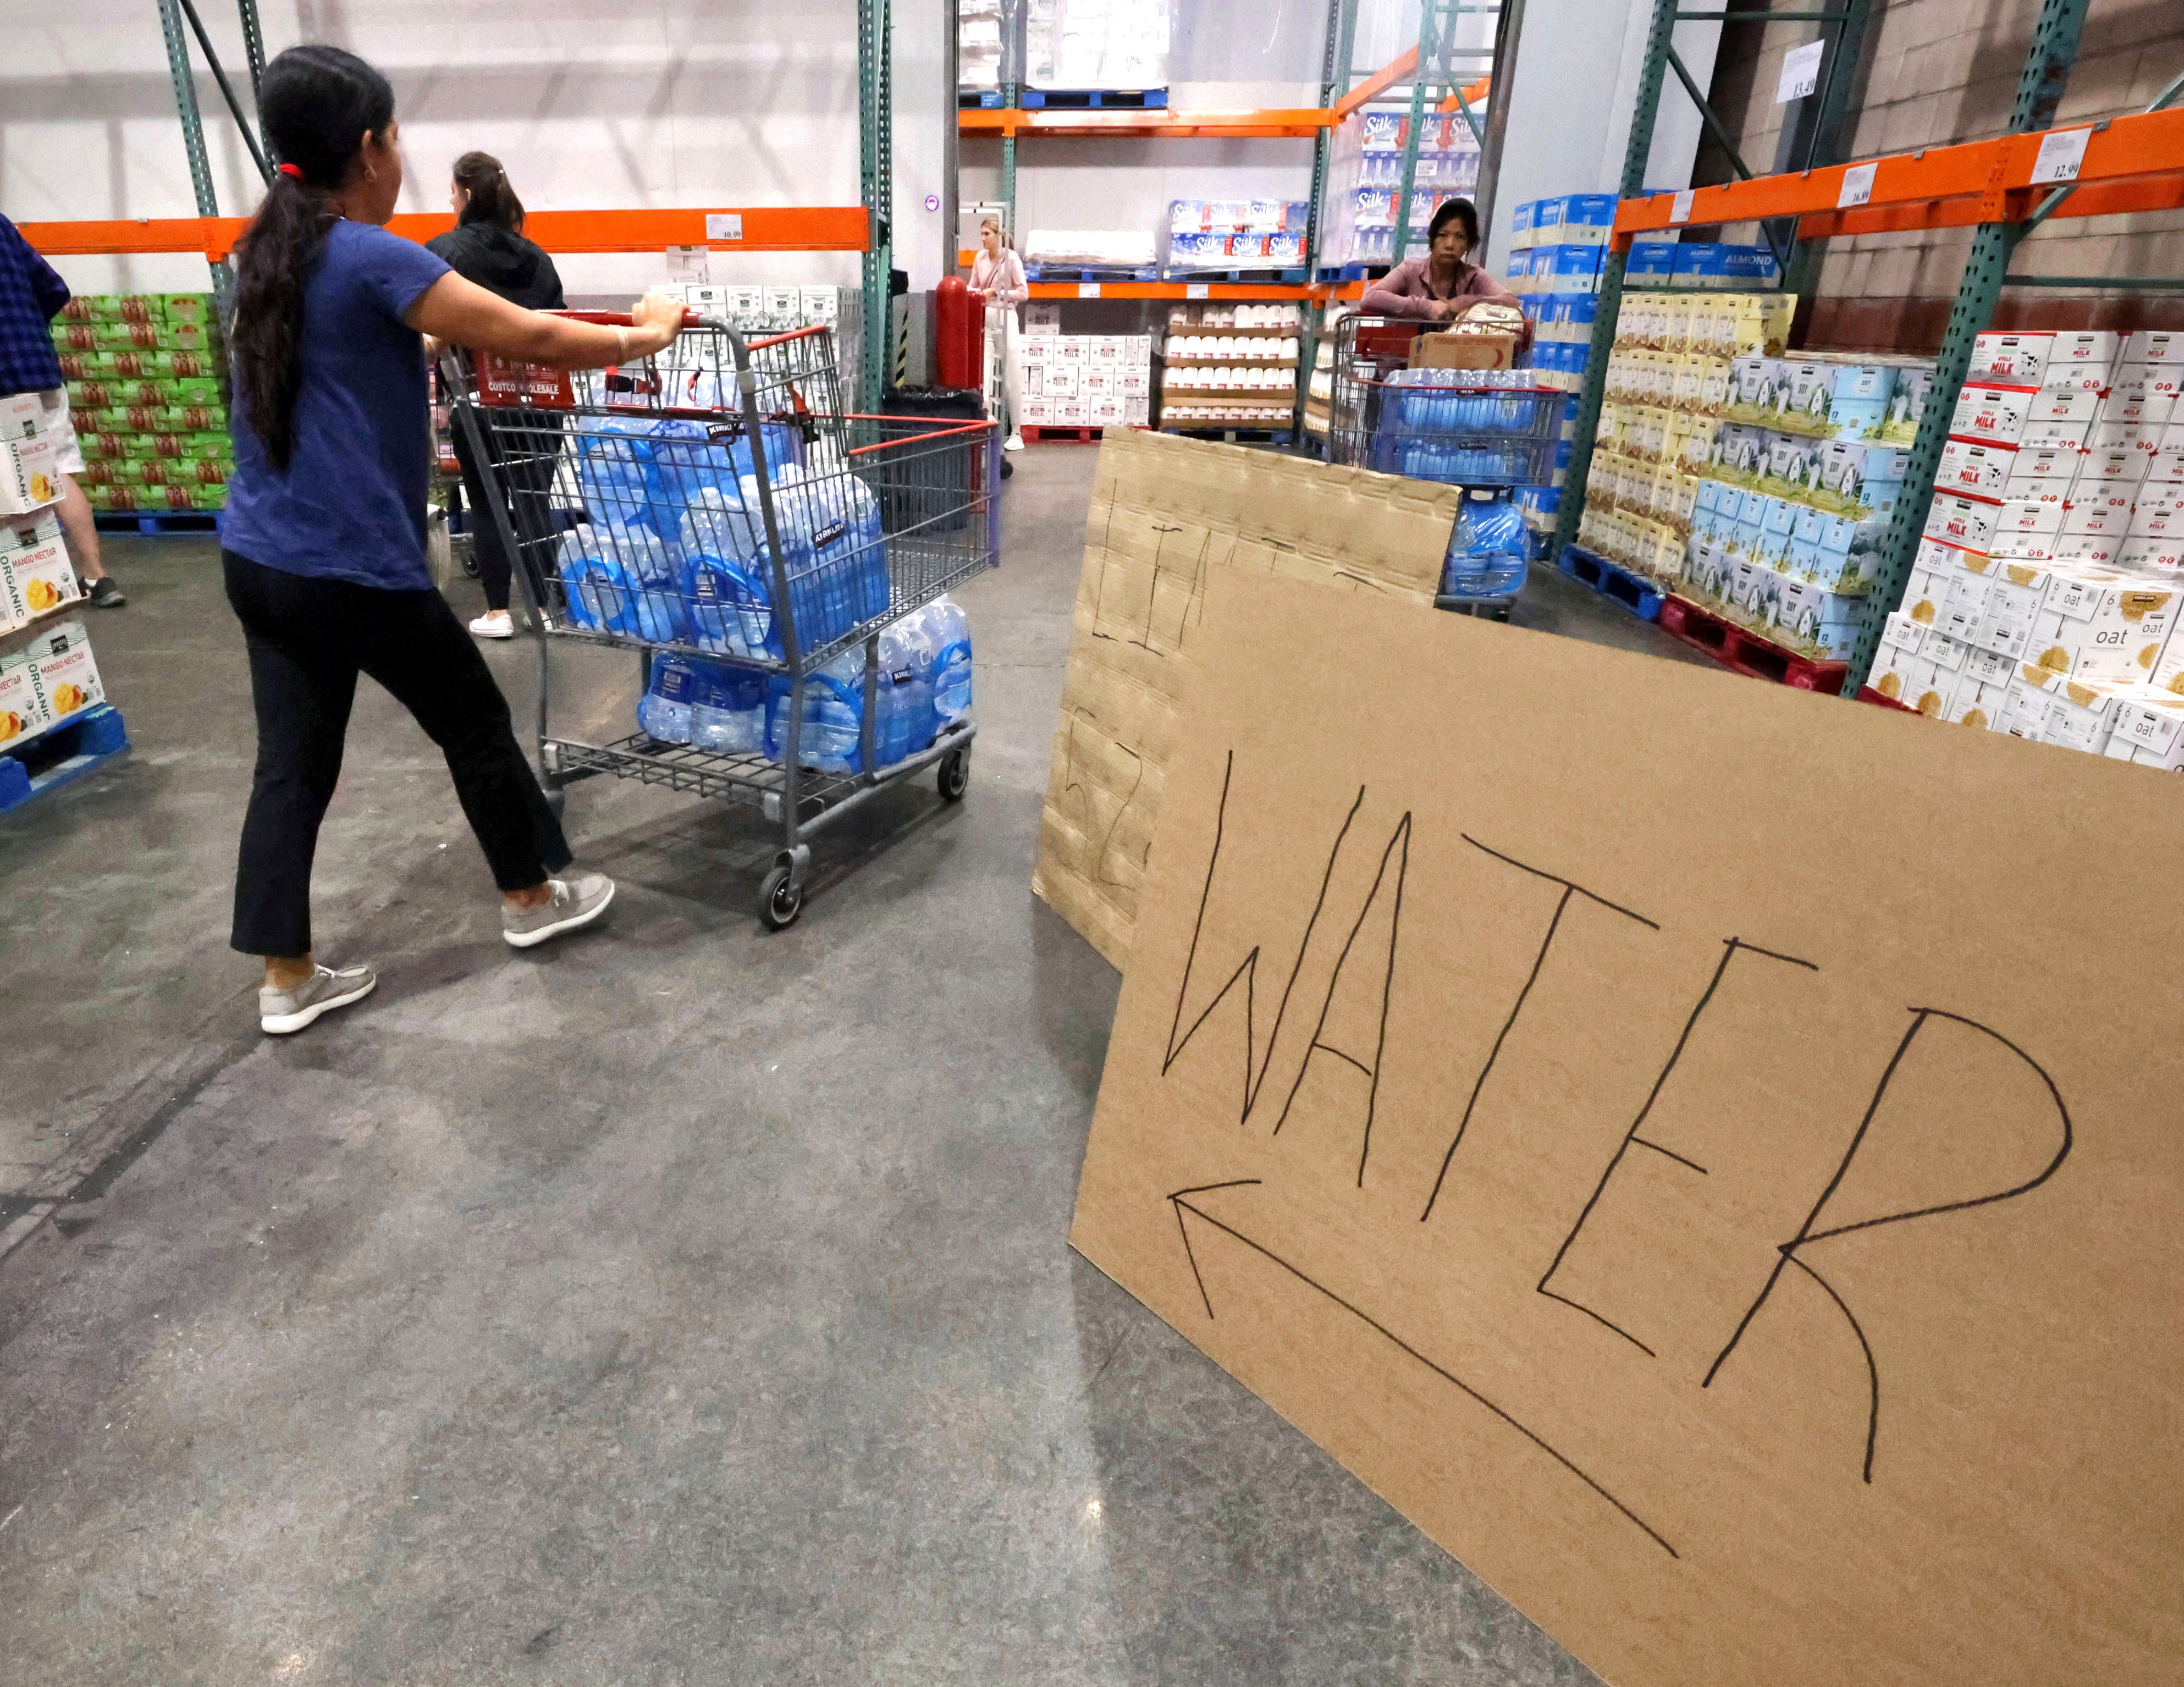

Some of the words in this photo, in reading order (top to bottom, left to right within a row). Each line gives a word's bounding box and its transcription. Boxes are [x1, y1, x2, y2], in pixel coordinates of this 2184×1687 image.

[1364, 115, 1392, 136] Silk
[2054, 163, 2079, 178] 12.99
[1356, 192, 1384, 211] Silk
[1173, 202, 1196, 220] Silk
[1194, 235, 1218, 253] Silk
[1232, 235, 1256, 253] Silk
[1269, 235, 1293, 253] Silk
[1725, 256, 1772, 266] ALMOND
[1990, 362, 2014, 374] MILK
[488, 382, 516, 392] COSTCO
[1797, 384, 1808, 394] SOY
[1831, 410, 1839, 420] 12
[1975, 416, 1997, 429] MILK
[1829, 461, 1841, 473] SOY
[10, 443, 31, 507] ORGANIC
[1959, 471, 1981, 484] MILK
[1862, 493, 1871, 503] 12
[1946, 522, 1967, 536] MILK
[12, 555, 34, 568] MANGO
[34, 547, 57, 561] NECTAR
[1929, 555, 1942, 566] oat
[0, 556, 24, 618] ORGANIC
[1984, 586, 1990, 596] 6
[2054, 580, 2060, 590] 6
[1786, 600, 1797, 612] SOY
[2031, 599, 2036, 609] 6
[2064, 594, 2081, 607] oat
[2107, 594, 2114, 605] 6
[2142, 622, 2164, 633] oat
[1897, 630, 1910, 641] oat
[2095, 629, 2128, 644] oat
[1936, 644, 1950, 657] oat
[41, 660, 64, 675] MANGO
[64, 652, 85, 666] NECTAR
[1982, 663, 1997, 675] oat
[0, 675, 22, 691] NECTAR
[2044, 701, 2050, 711] 6
[2125, 707, 2132, 718] 6
[2091, 721, 2097, 732] 6
[2136, 723, 2155, 737] oat
[1161, 748, 2073, 1484] WATER
